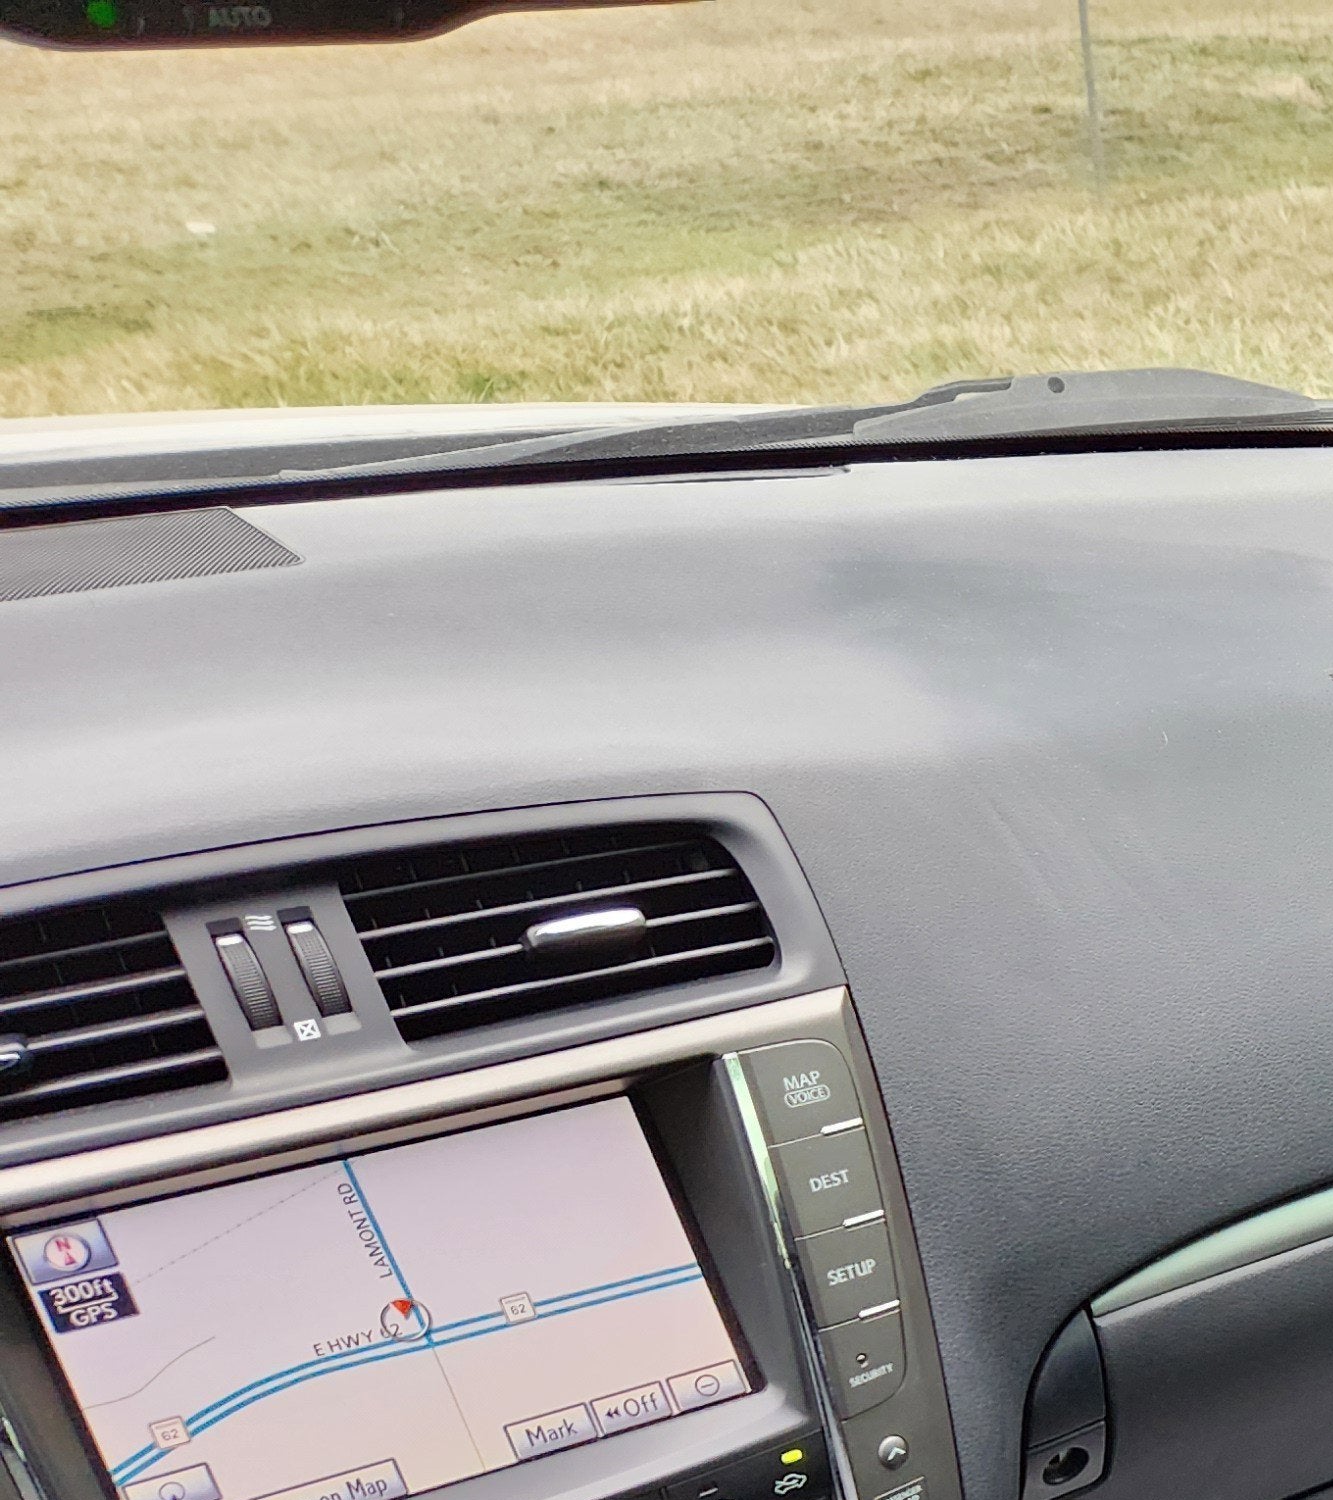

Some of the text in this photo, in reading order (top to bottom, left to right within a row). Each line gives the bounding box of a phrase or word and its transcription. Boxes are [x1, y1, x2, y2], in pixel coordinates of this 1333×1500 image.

[783, 1070, 821, 1091] MAP
[788, 1086, 827, 1104] VOICE
[809, 1169, 850, 1192] DEST
[336, 1182, 393, 1279] LAMONT RD
[54, 1237, 72, 1252] N
[826, 1258, 877, 1286] SETUP
[49, 1277, 114, 1308] 300ft
[69, 1302, 118, 1327] GPS
[510, 1303, 527, 1316] 62
[313, 1343, 326, 1357] E
[327, 1328, 373, 1354] HWY
[848, 1362, 894, 1388] SECURITY
[623, 1391, 659, 1418] Off
[161, 1428, 180, 1441] 62
[525, 1418, 579, 1447] Mark
[346, 1477, 389, 1500] Map
